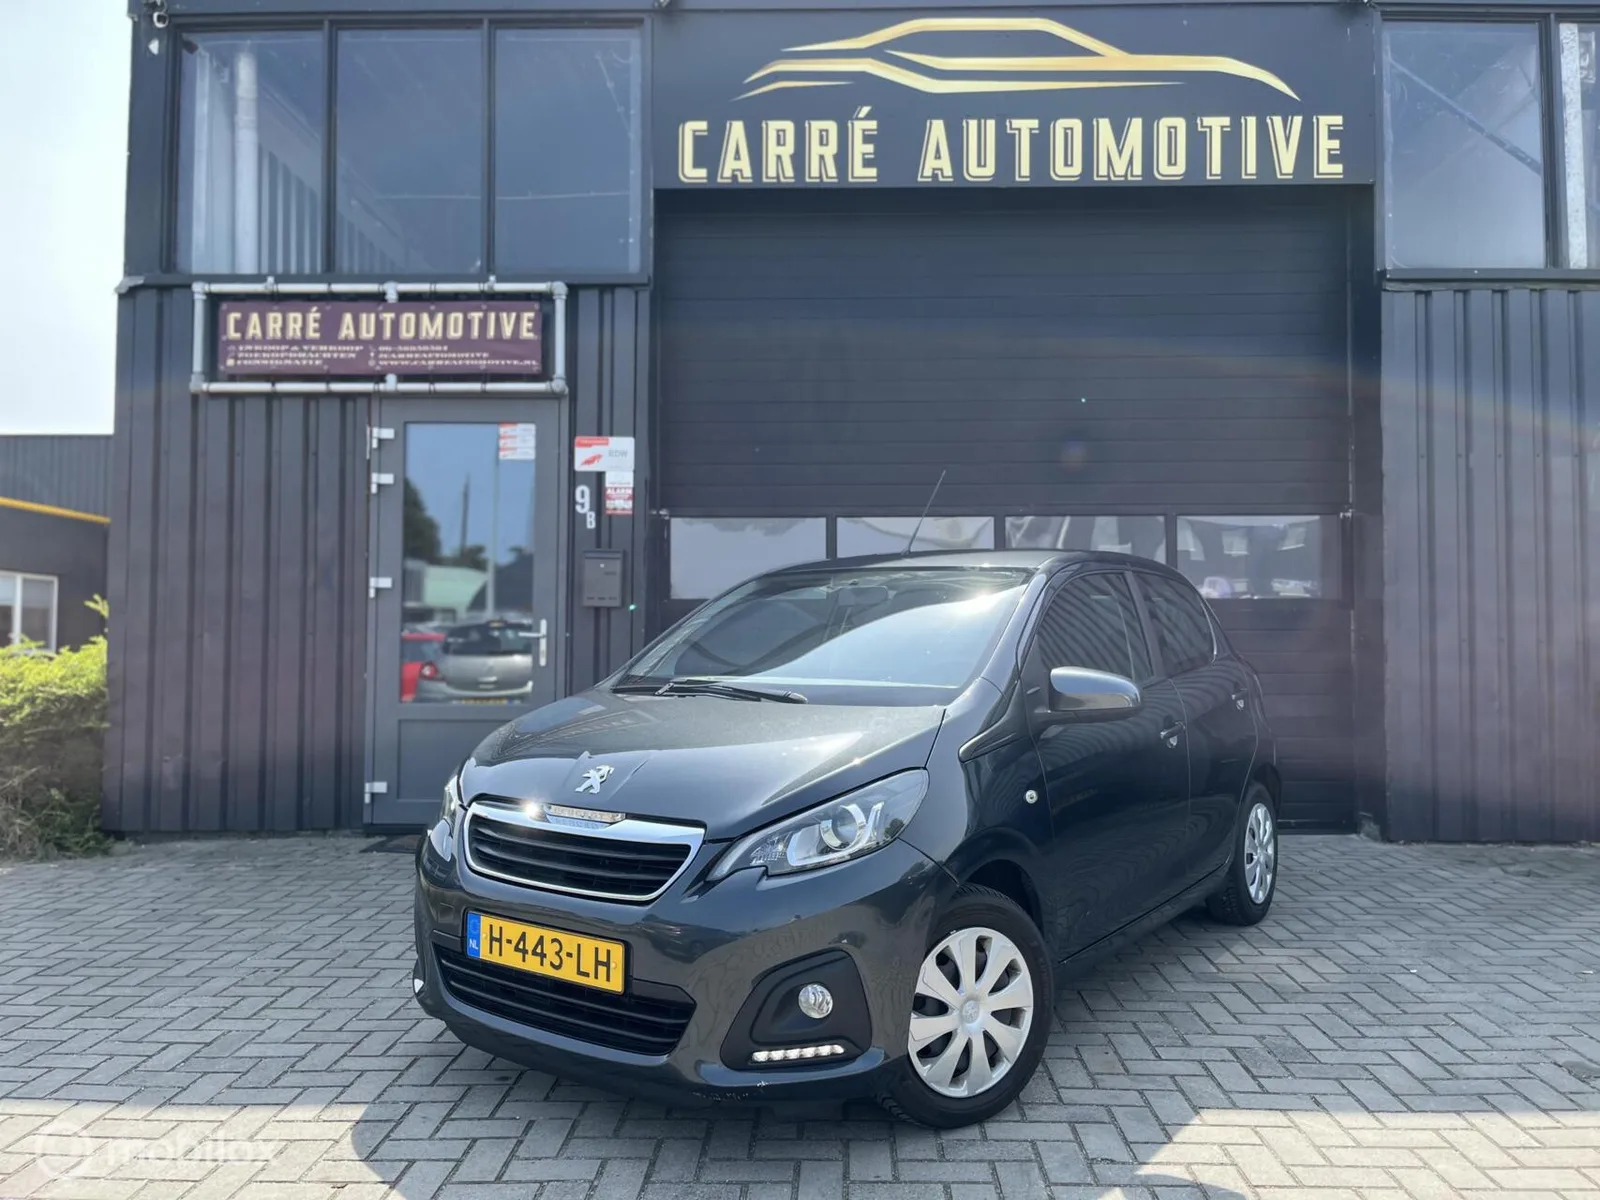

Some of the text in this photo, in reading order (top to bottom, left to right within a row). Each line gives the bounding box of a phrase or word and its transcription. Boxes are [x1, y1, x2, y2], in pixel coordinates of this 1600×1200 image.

[677, 105, 1346, 184] CARRÉ AUTOMOTIVE
[226, 306, 538, 341] CARRÉ AUTOMOTIVE
[575, 484, 590, 514] 9
[606, 487, 633, 495] ALARM
[468, 937, 480, 951] NL
[488, 923, 611, 983] H-443-LH
